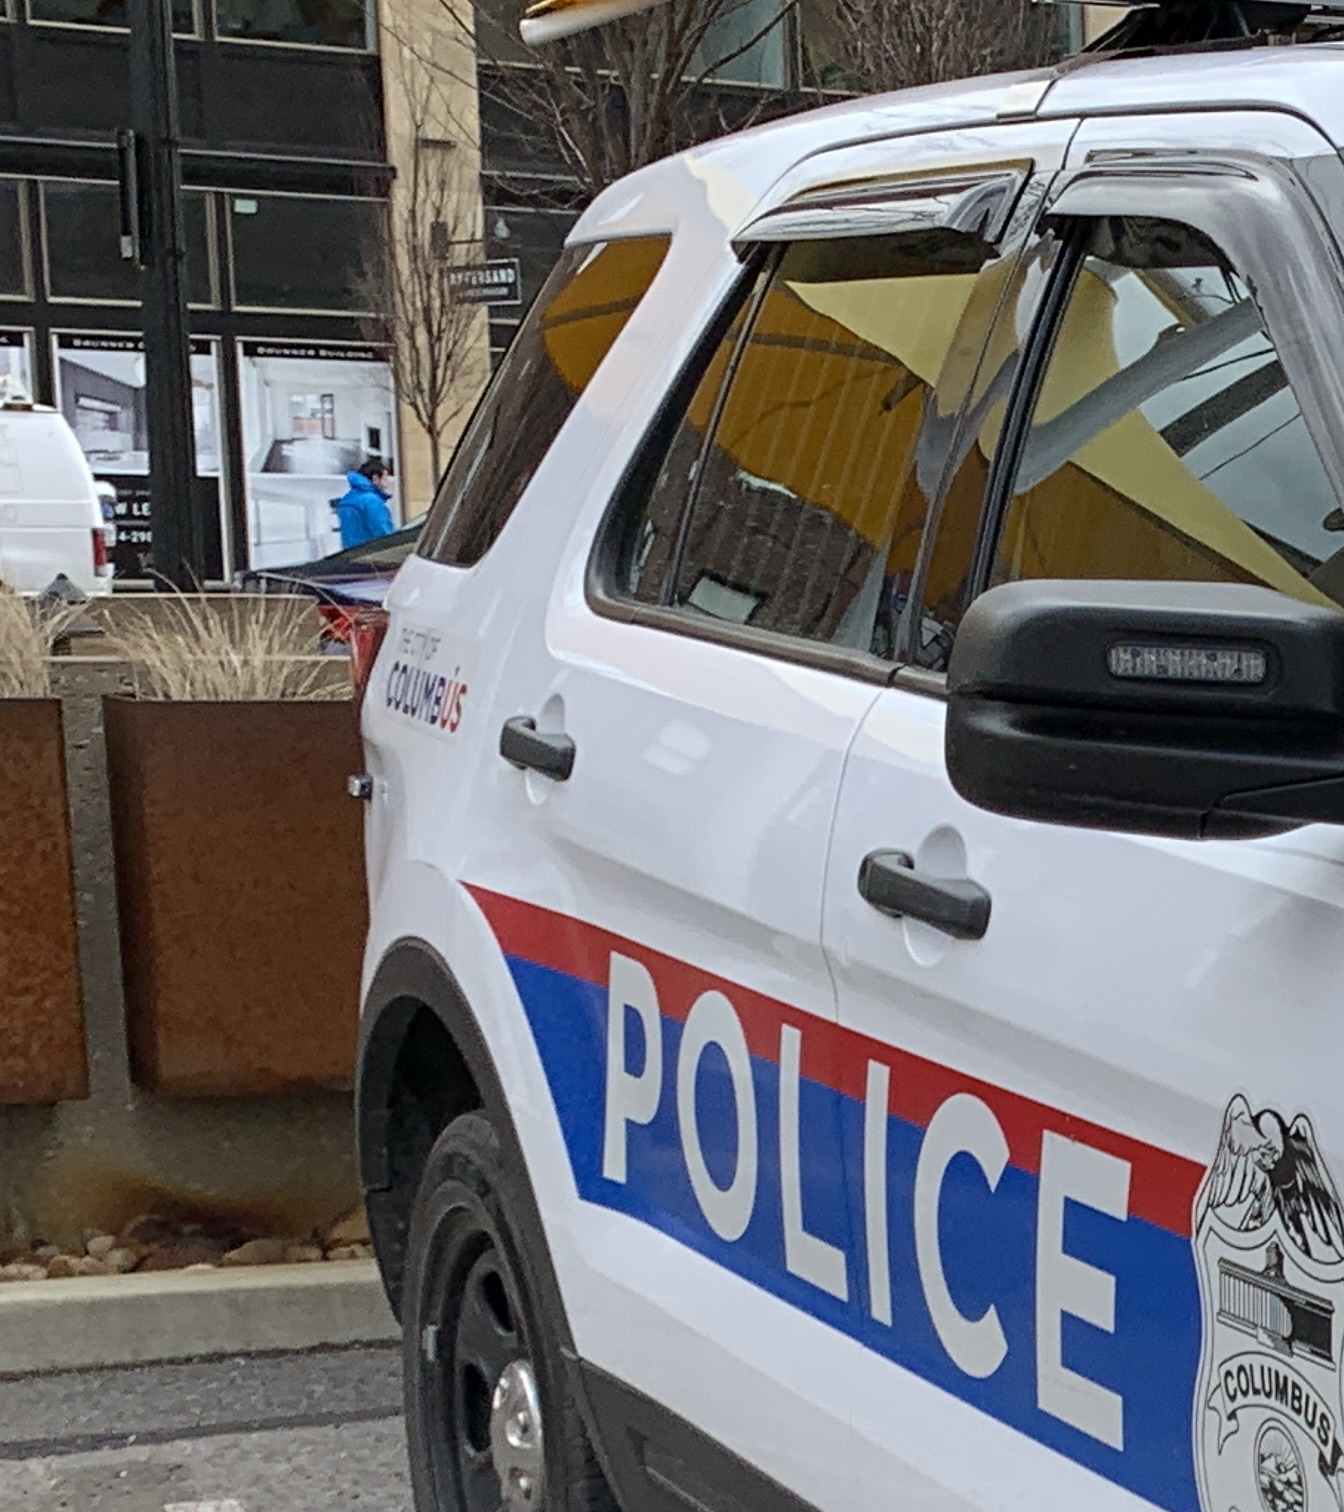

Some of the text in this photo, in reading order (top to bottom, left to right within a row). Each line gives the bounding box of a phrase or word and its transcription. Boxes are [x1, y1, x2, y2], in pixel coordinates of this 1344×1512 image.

[386, 660, 468, 733] COLUMBUS
[602, 950, 1132, 1452] POLICE
[1224, 1363, 1332, 1447] COLUMBUS
